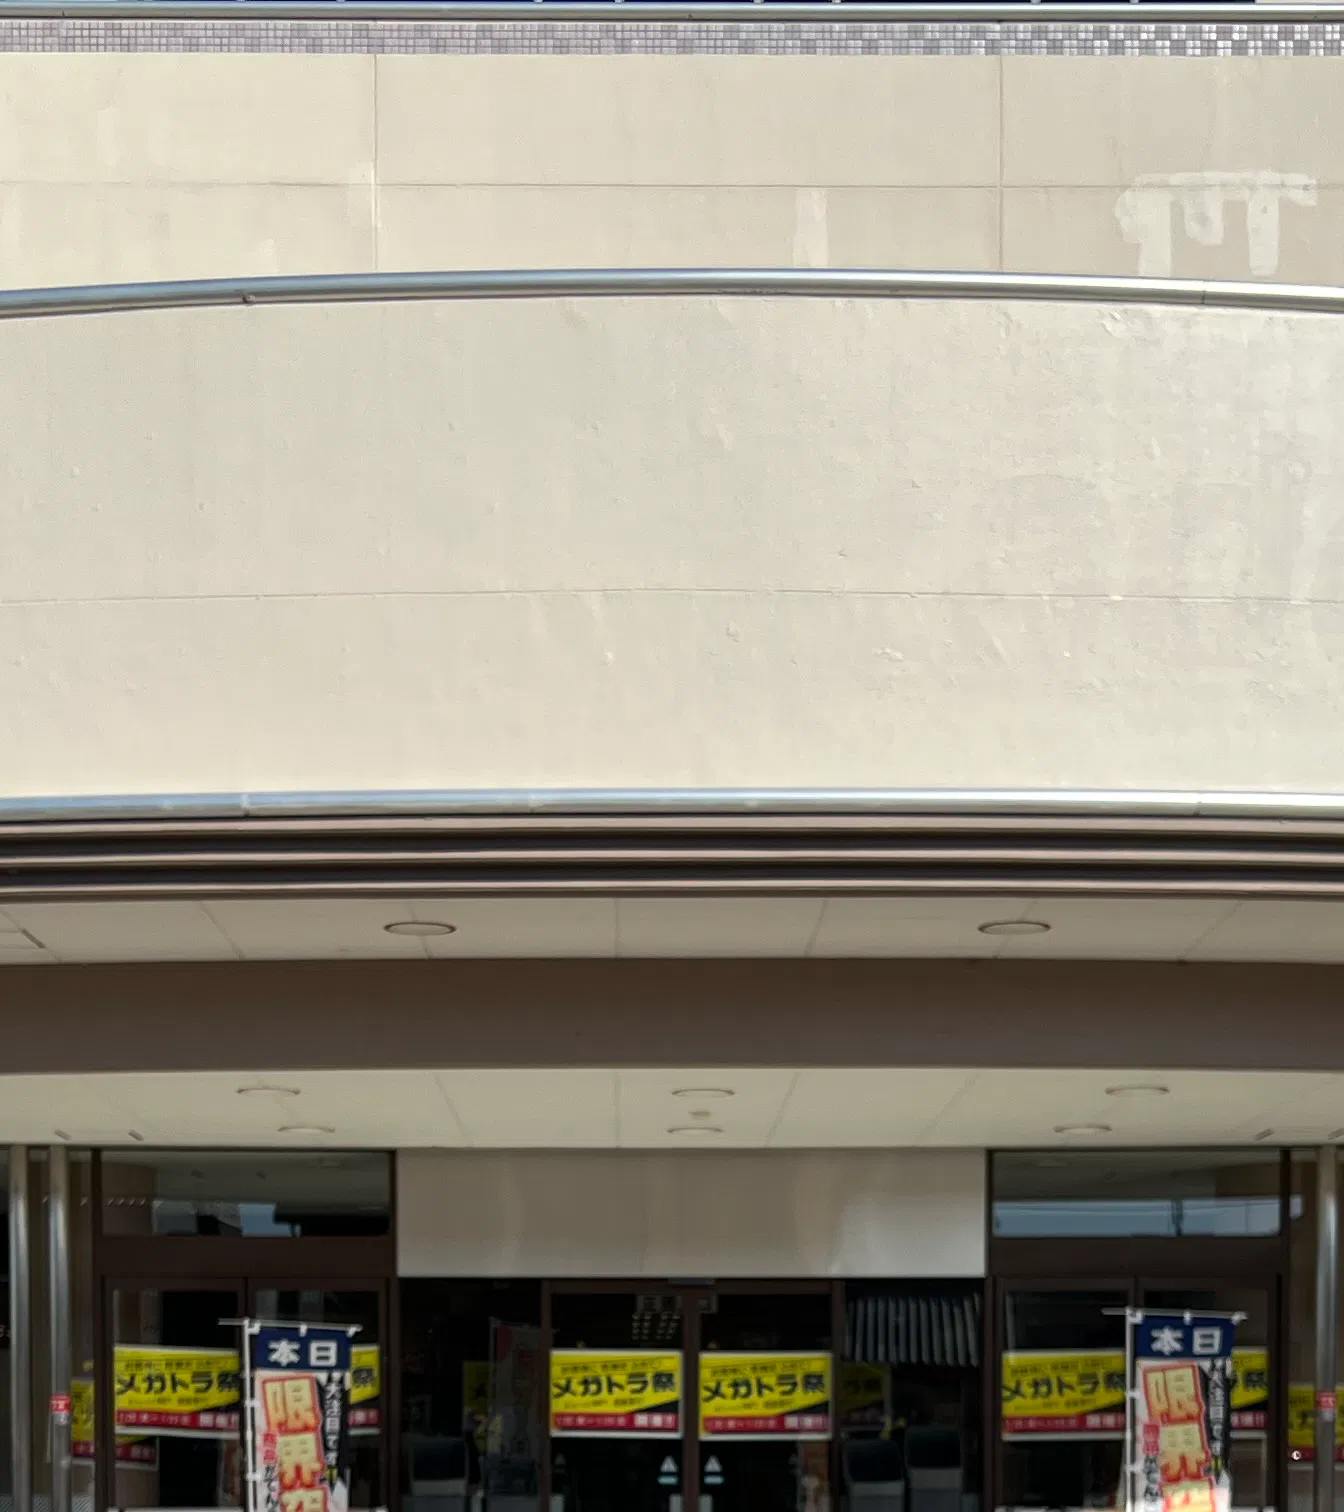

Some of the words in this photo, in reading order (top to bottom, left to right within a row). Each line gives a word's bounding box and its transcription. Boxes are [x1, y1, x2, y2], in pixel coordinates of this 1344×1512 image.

[268, 1338, 338, 1367] 本日
[1150, 1327, 1223, 1356] 本日
[552, 1371, 677, 1398] メガトラ祭
[702, 1374, 828, 1402] メガトラ祭
